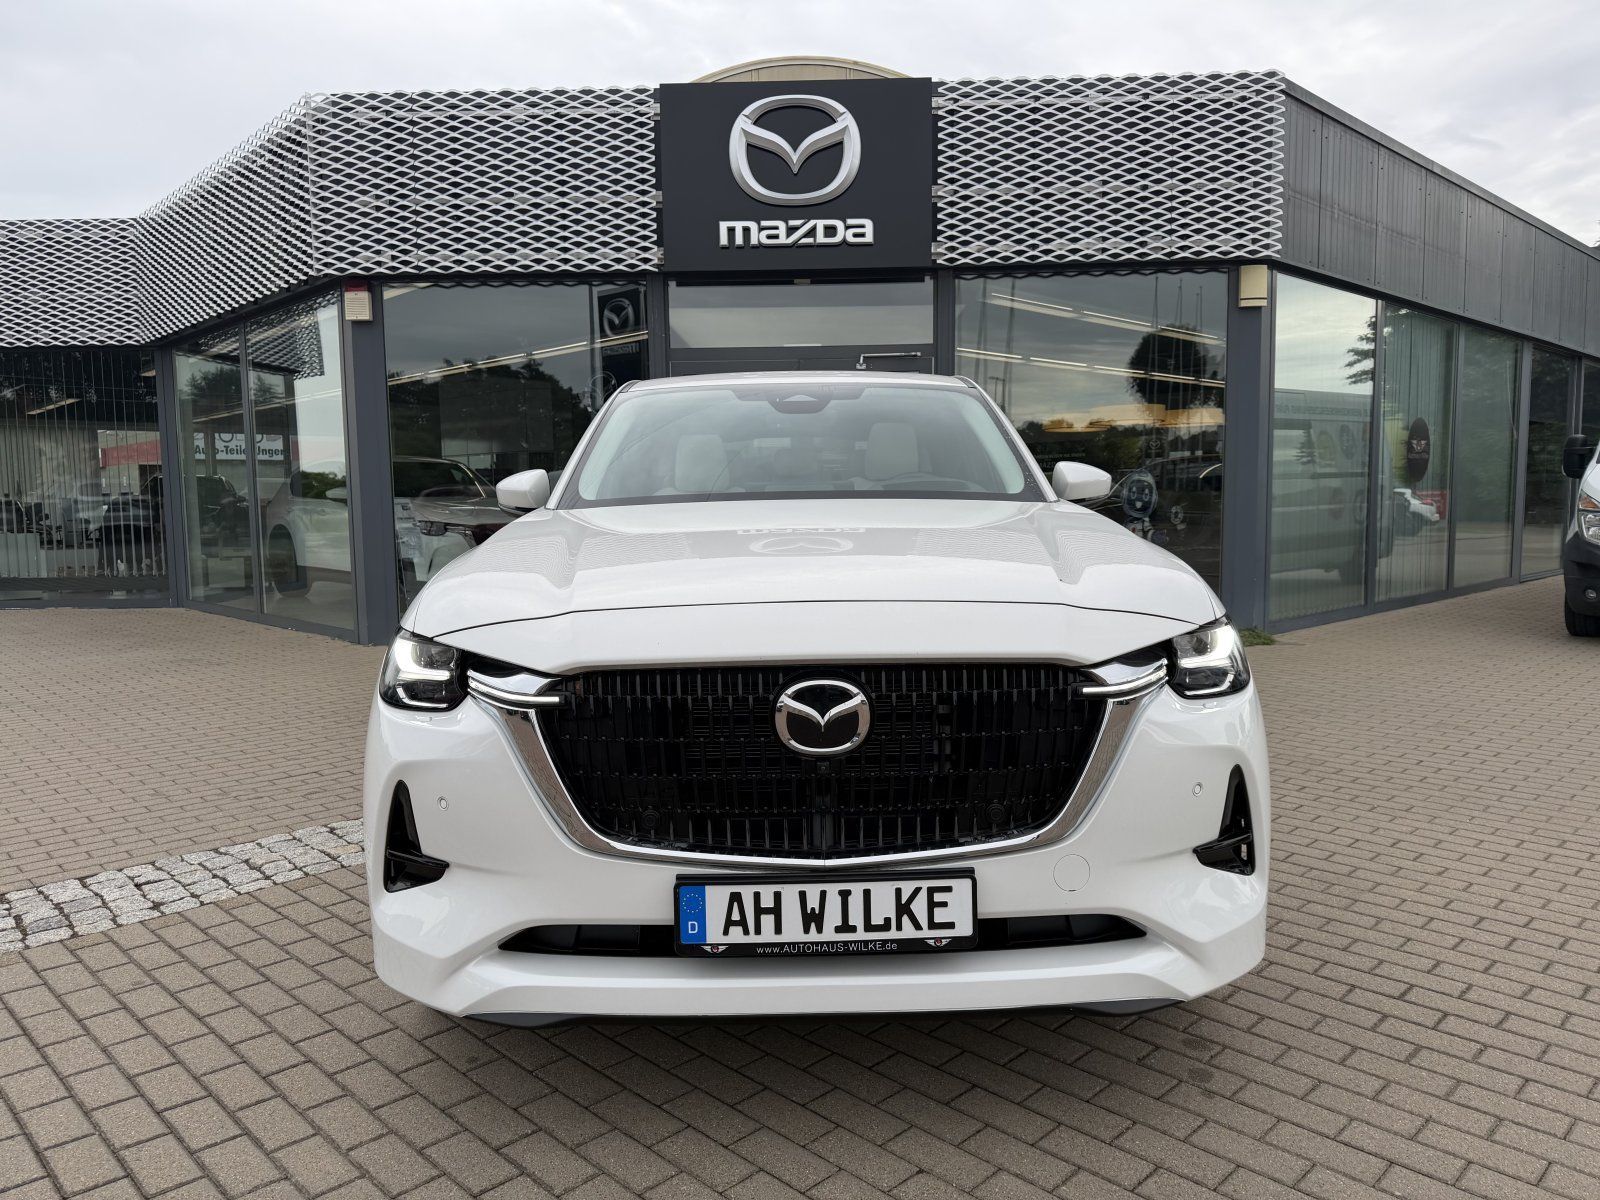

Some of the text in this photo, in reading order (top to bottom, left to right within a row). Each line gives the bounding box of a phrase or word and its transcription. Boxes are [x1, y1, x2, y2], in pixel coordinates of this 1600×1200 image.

[722, 885, 956, 936] AH WILKE
[688, 921, 698, 934] D
[756, 941, 898, 954] www.AUTOHAUS-WILKE.de
